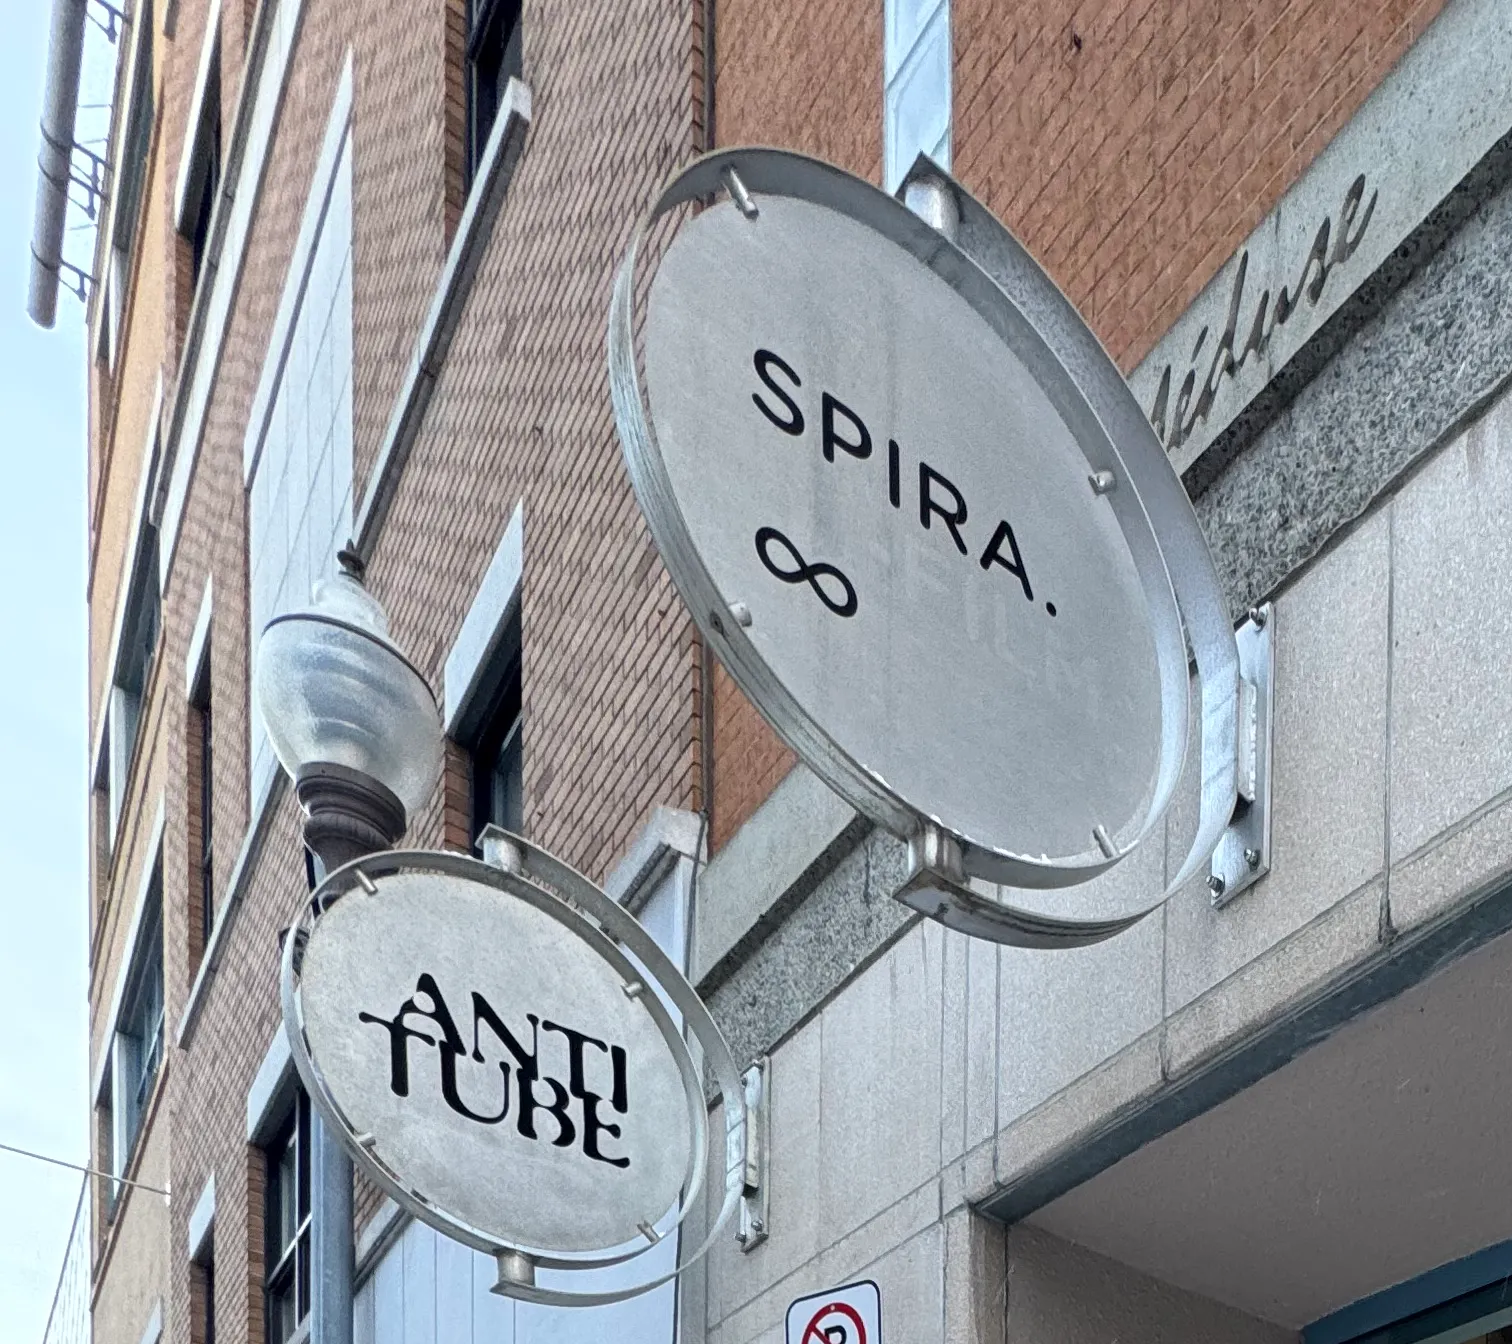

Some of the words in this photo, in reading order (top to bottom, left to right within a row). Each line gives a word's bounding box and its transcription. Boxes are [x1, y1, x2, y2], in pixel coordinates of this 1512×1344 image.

[752, 348, 1058, 617] SPIRA.
[358, 1012, 631, 1169] TUBE
[395, 973, 627, 1113] ANTI
